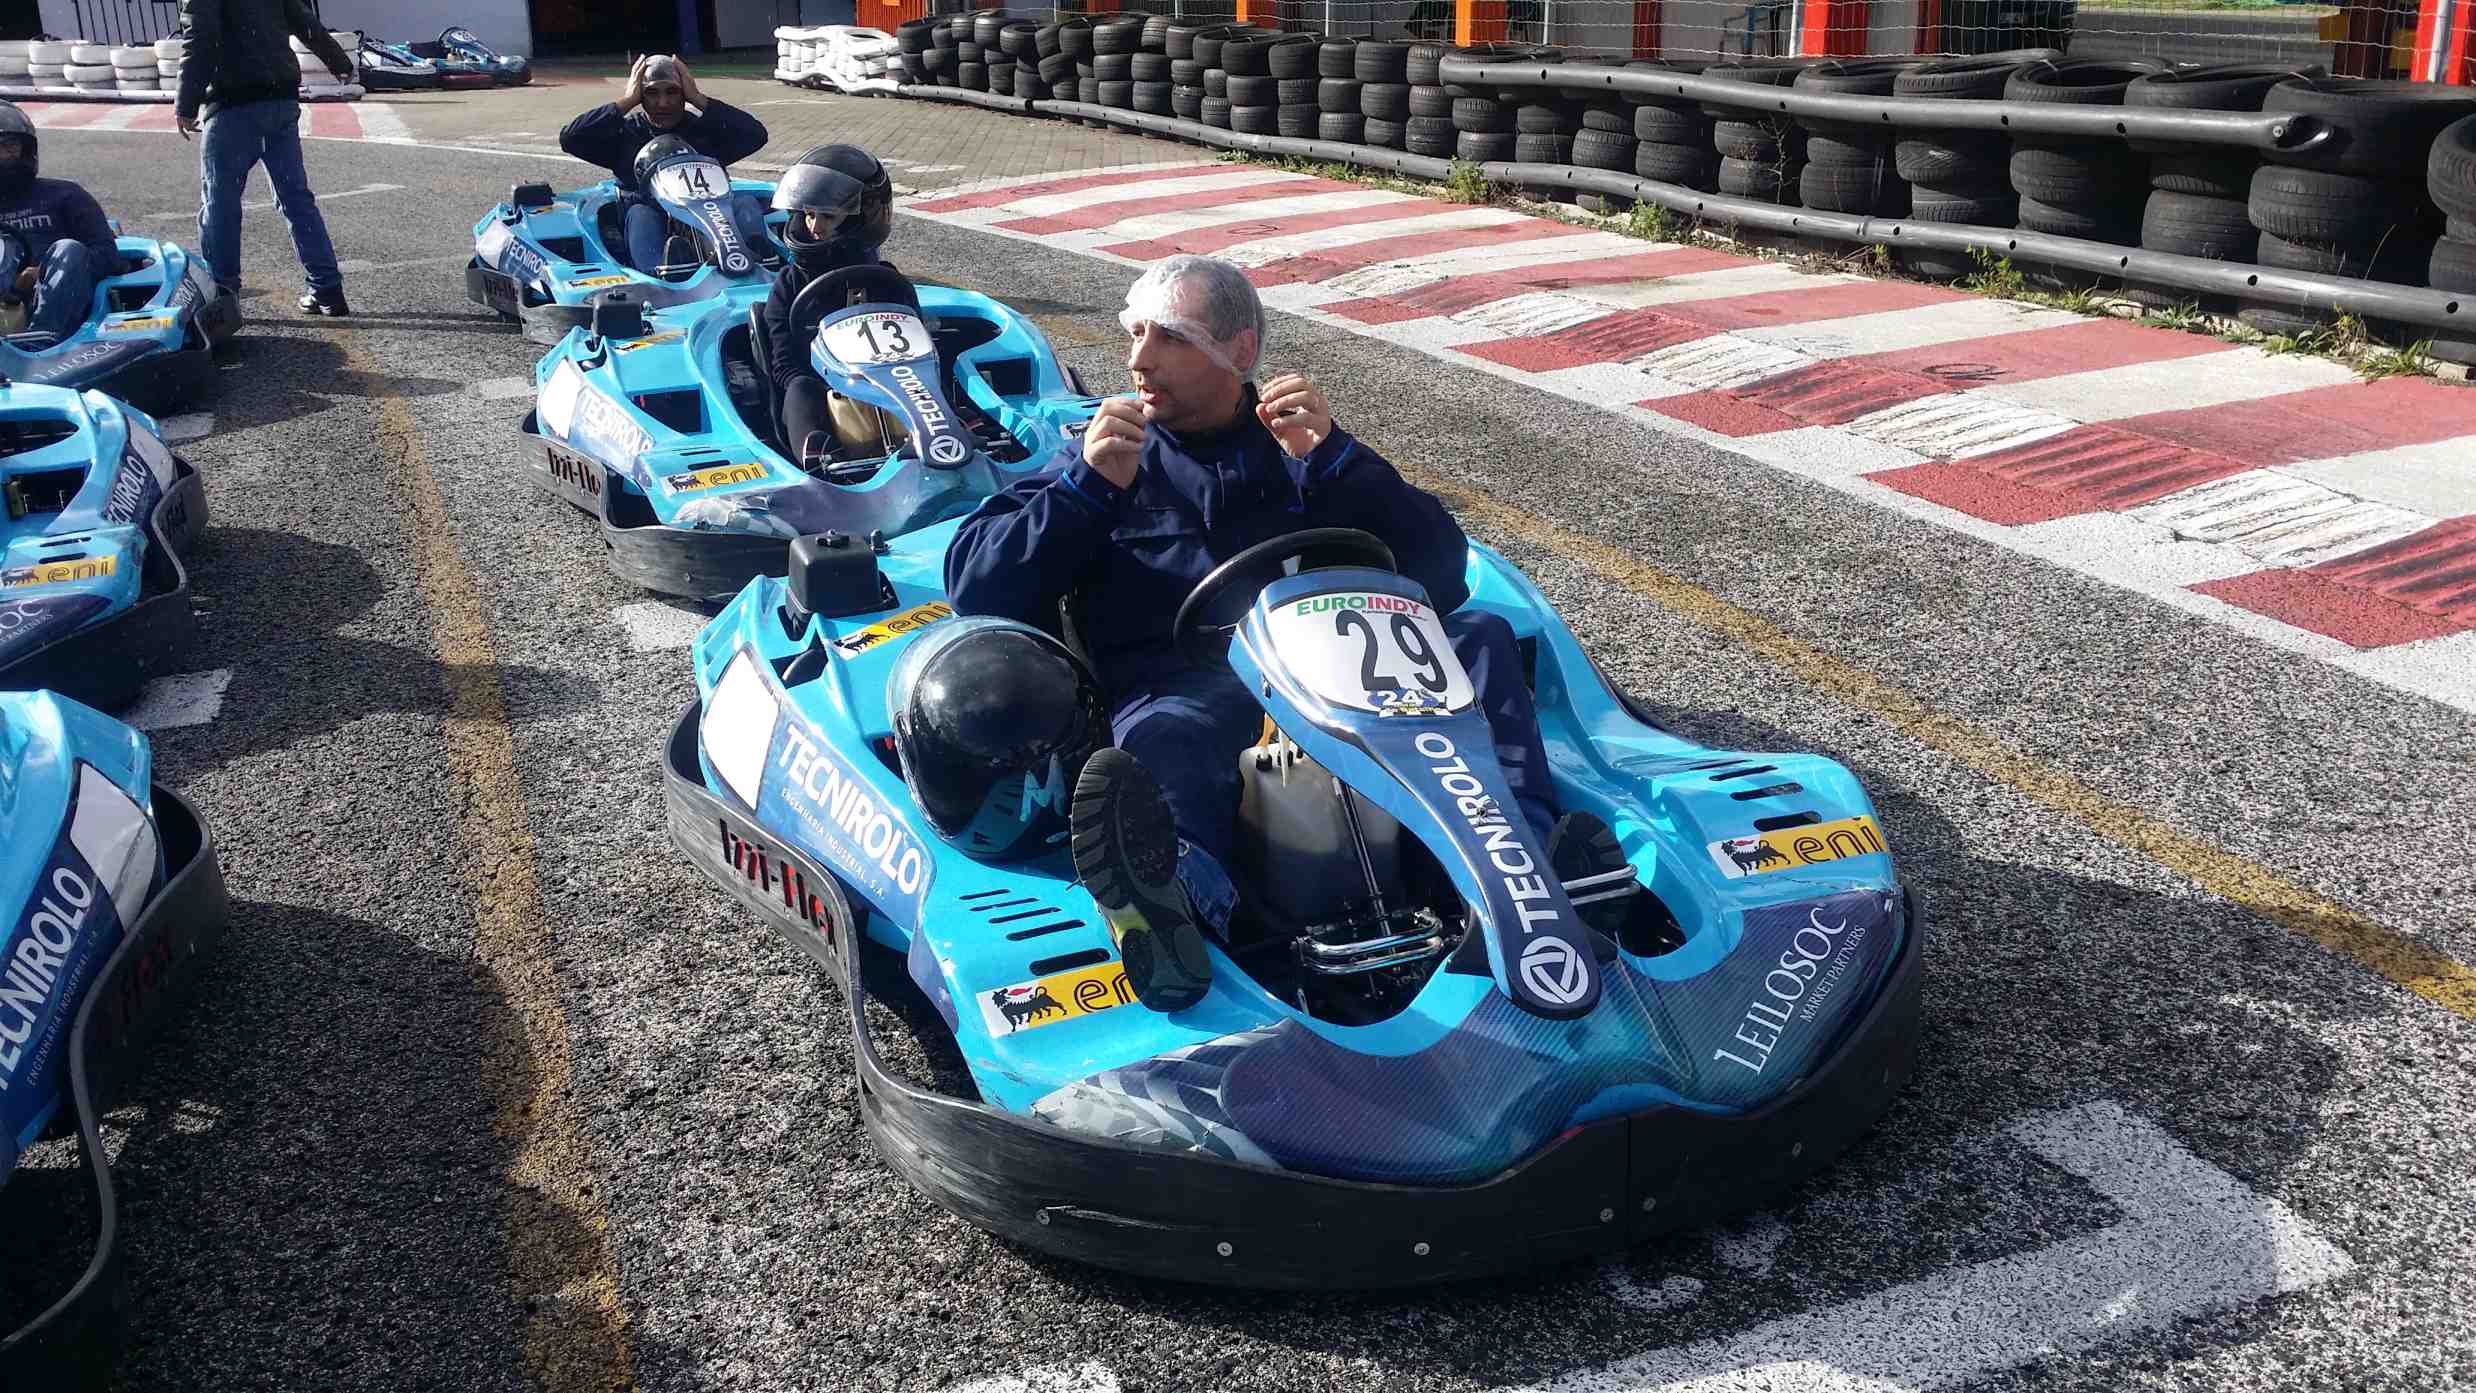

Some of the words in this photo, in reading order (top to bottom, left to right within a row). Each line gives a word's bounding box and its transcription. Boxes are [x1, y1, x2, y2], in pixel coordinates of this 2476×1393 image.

[678, 167, 710, 194] 14
[506, 239, 546, 276] TECNIRO
[836, 314, 908, 330] EUROINDY
[857, 320, 910, 355] 13
[709, 464, 763, 487] eni
[48, 556, 108, 583] eni
[887, 602, 952, 633] eni
[1297, 595, 1421, 617] EUROINDY
[1336, 609, 1448, 693] 29
[779, 724, 921, 895] TECNIROLO
[1415, 731, 1560, 934] TECNIROLO
[1793, 817, 1882, 866] eni
[1714, 907, 1847, 1074] LEILOSOC
[1800, 976, 1834, 1023] MARKET
[1828, 925, 1866, 980] PARTNERS
